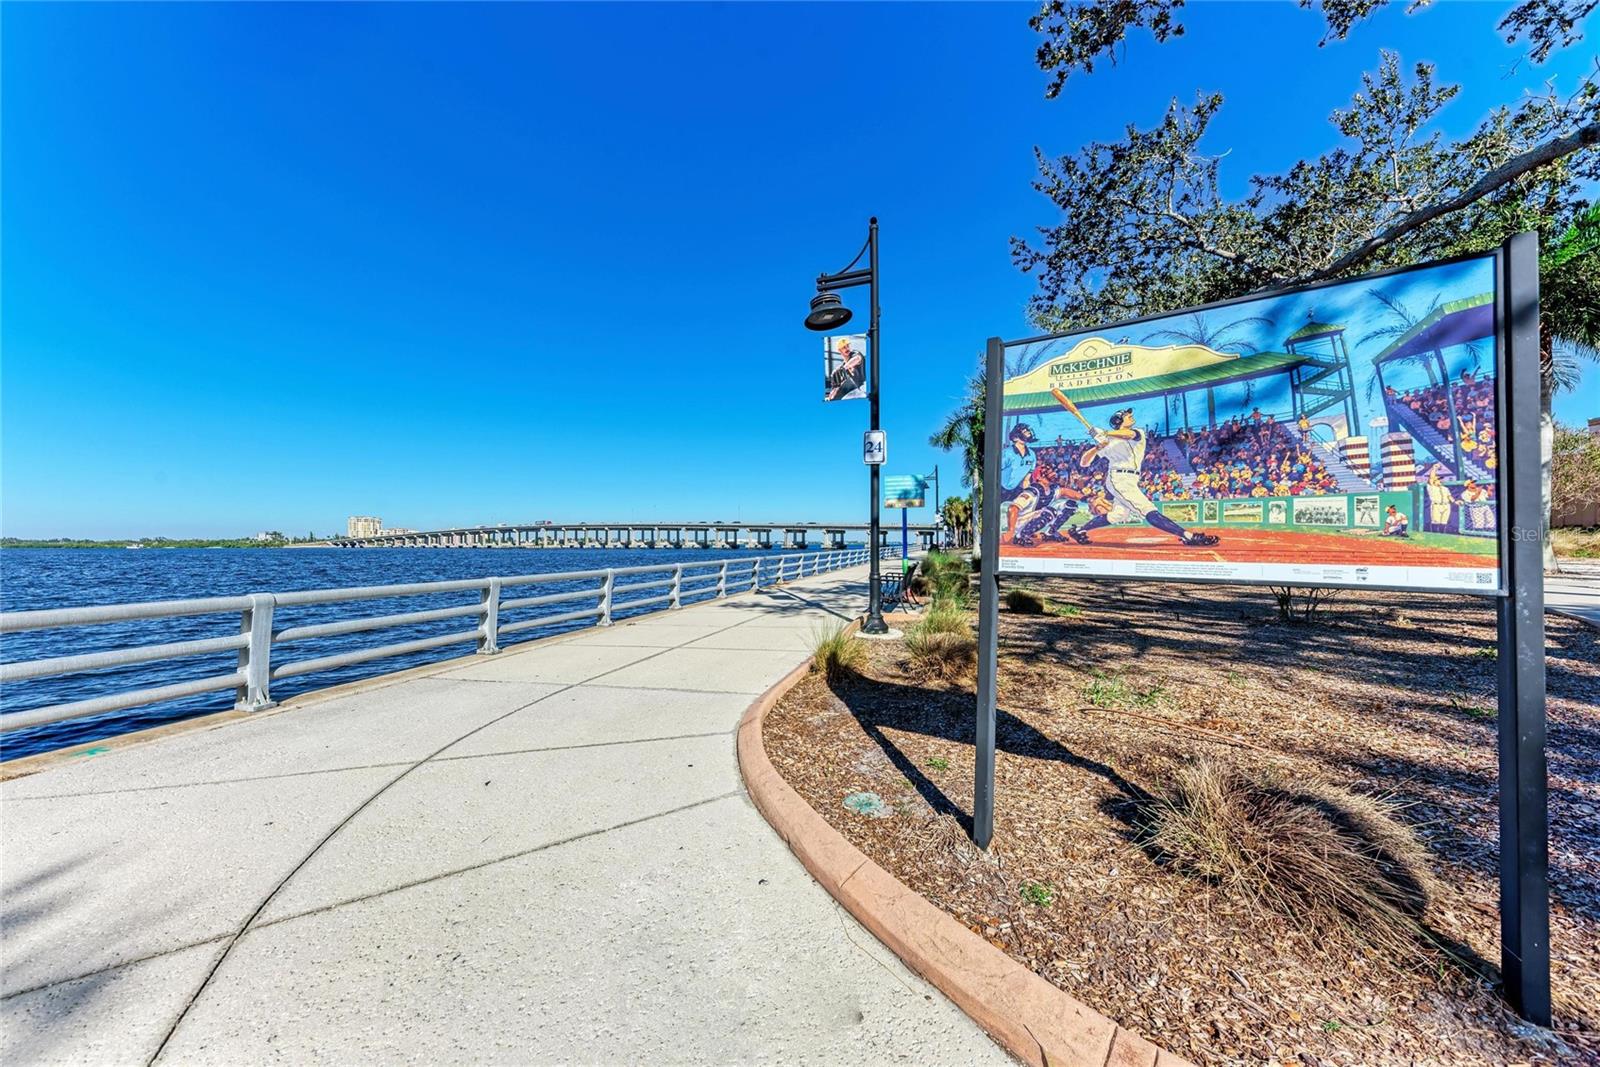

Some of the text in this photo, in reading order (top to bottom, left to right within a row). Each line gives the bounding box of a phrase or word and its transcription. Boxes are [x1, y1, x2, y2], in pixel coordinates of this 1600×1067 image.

[1052, 353, 1131, 374] McKECHNIE
[1049, 371, 1134, 388] BRADENTON
[865, 441, 883, 453] 24
